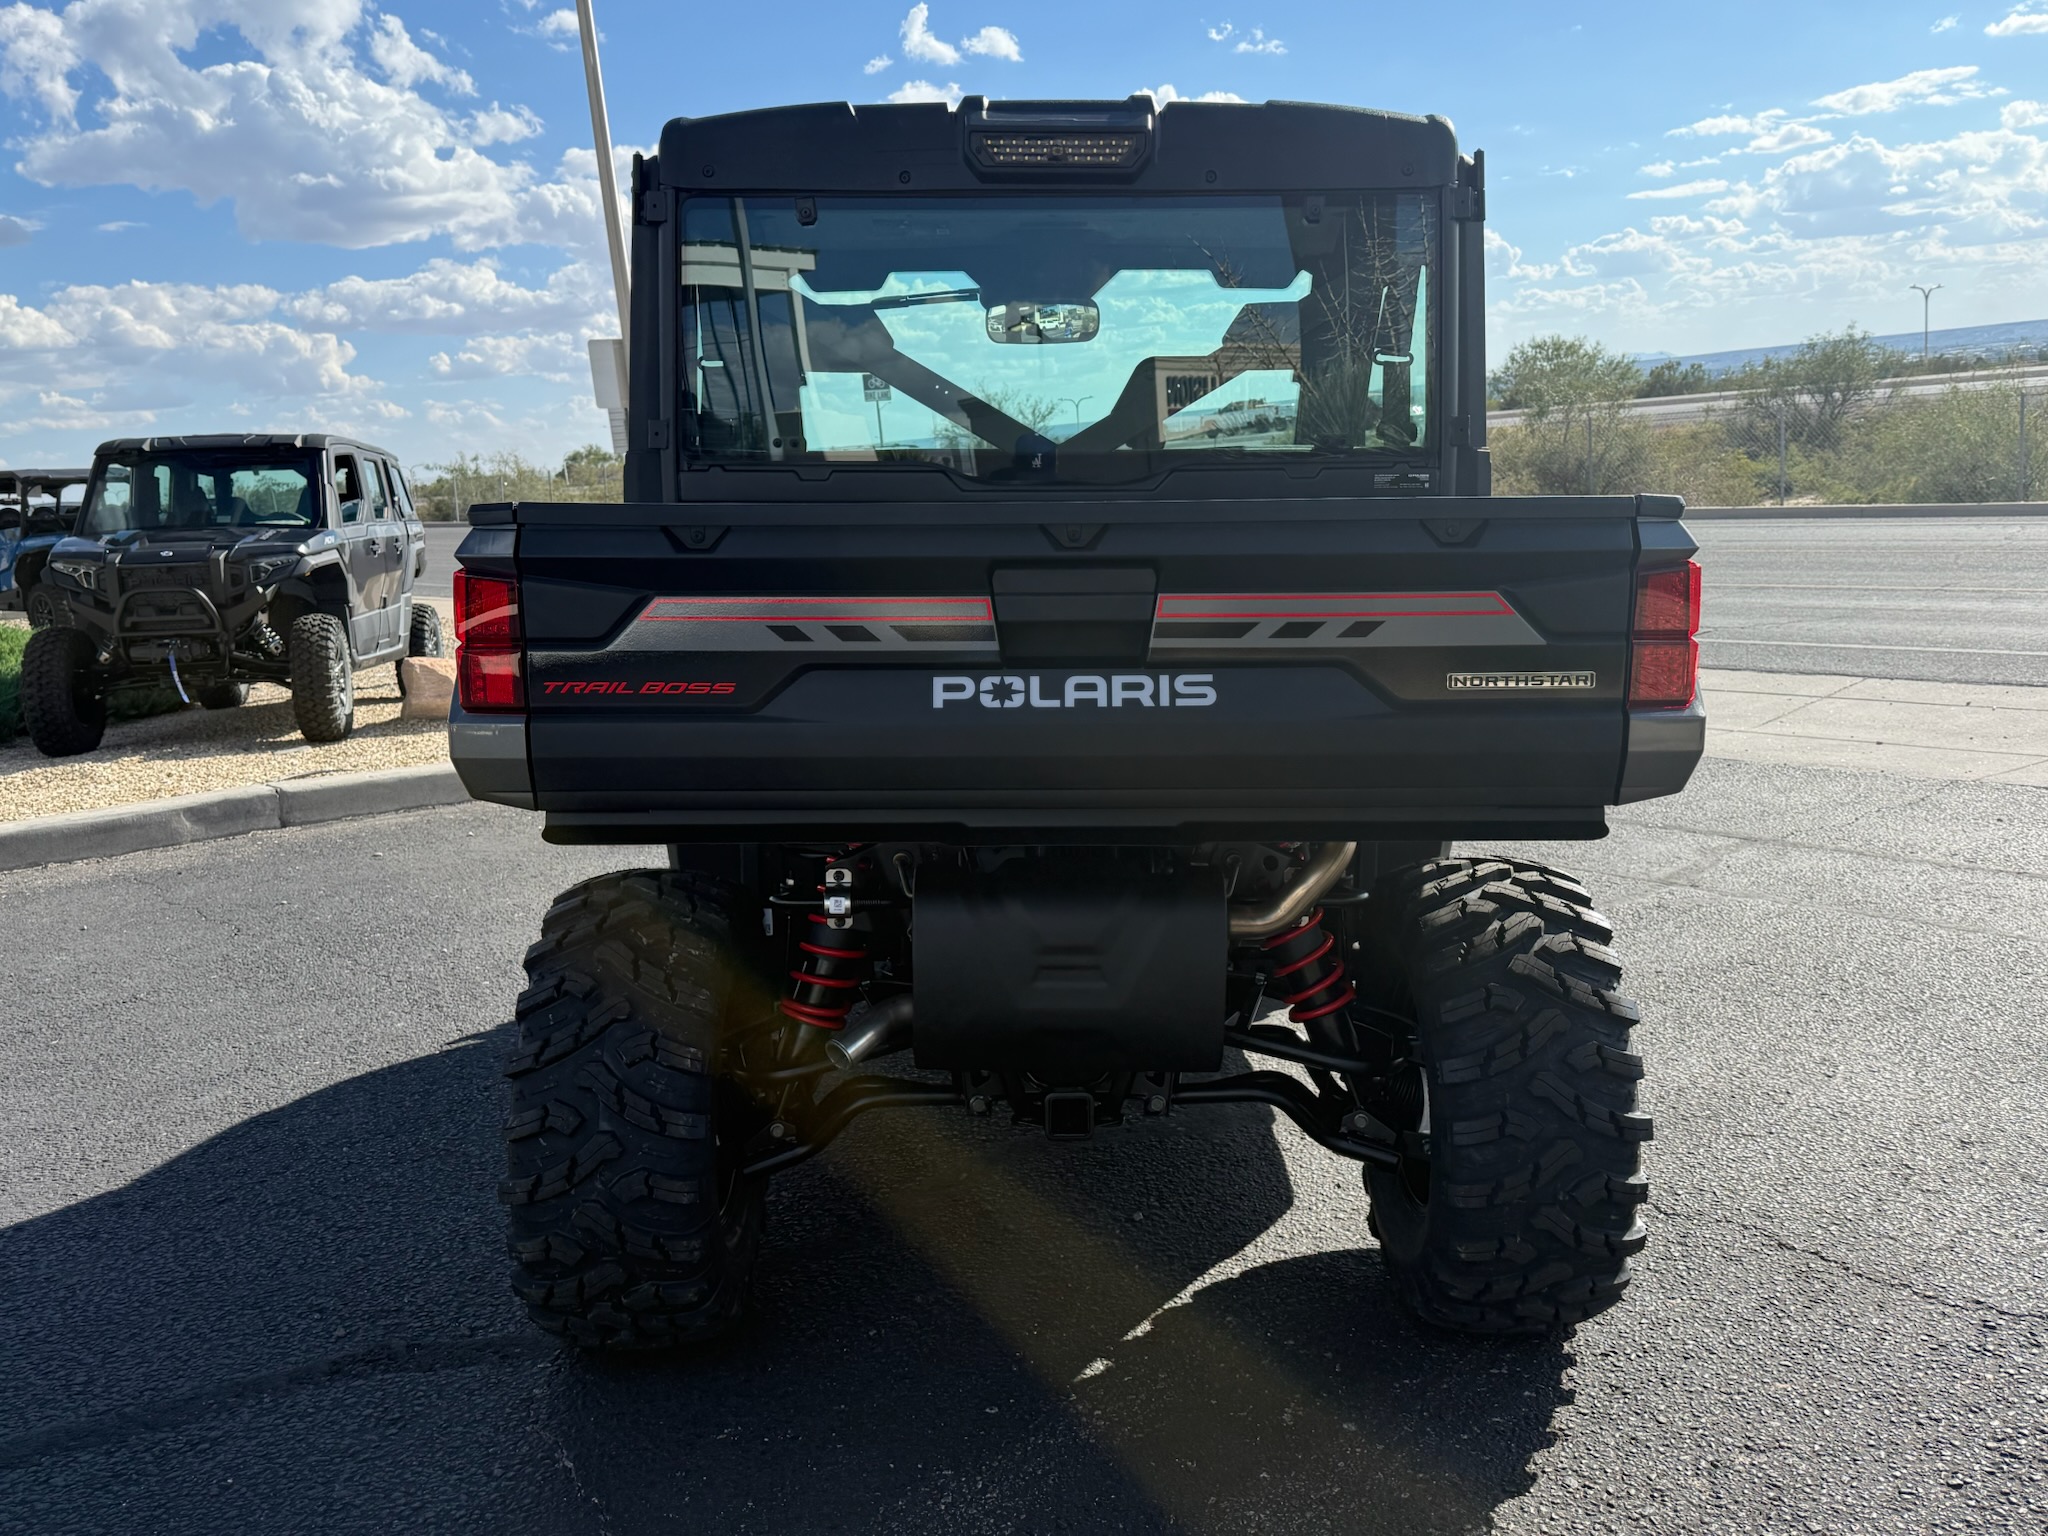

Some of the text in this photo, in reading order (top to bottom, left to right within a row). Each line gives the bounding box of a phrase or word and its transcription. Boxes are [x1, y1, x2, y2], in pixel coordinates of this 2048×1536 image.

[543, 681, 737, 694] TRAIL BOSS
[1452, 674, 1590, 688] NORTHSTAR
[933, 674, 1217, 709] POLARIS
